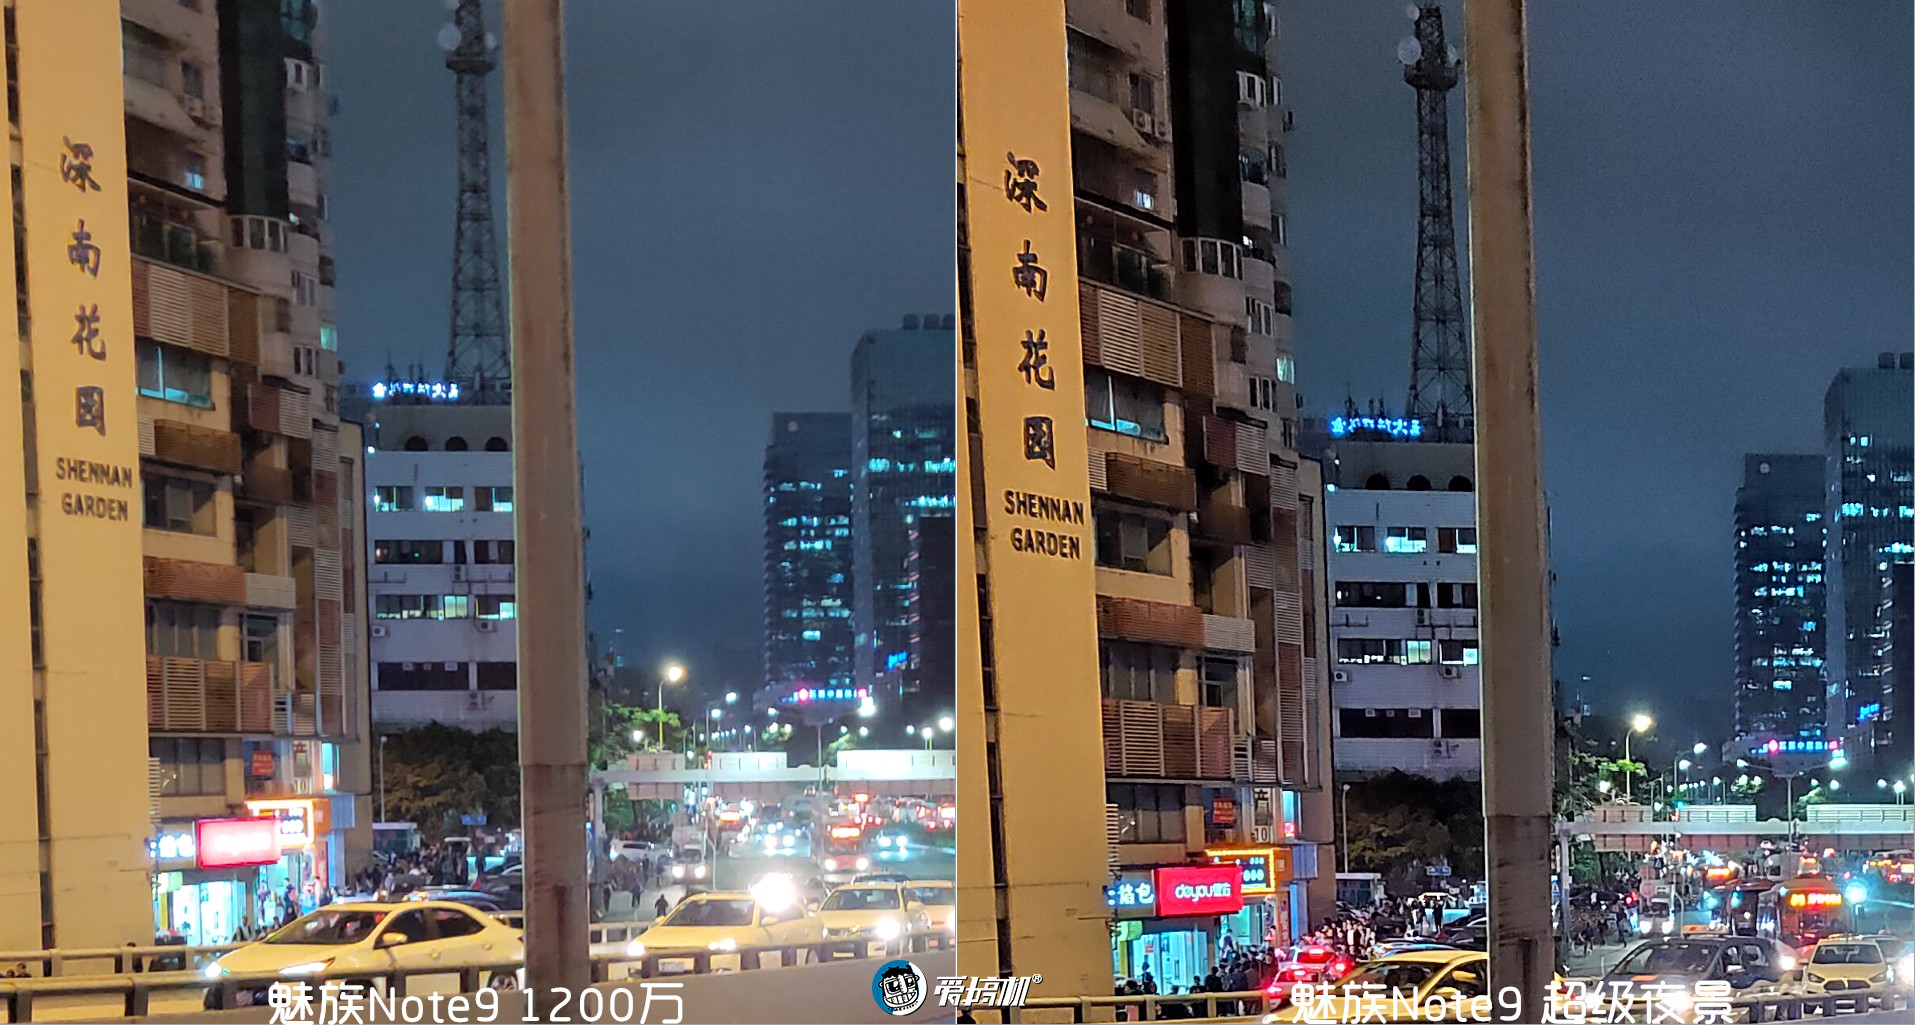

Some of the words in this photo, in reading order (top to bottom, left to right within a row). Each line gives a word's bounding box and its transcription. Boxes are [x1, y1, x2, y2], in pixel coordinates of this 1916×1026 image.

[56, 457, 133, 489] SHENNAN
[61, 492, 129, 521] GARDEN
[1004, 489, 1085, 526] SHENNAN
[1011, 526, 1080, 561] GARDEN
